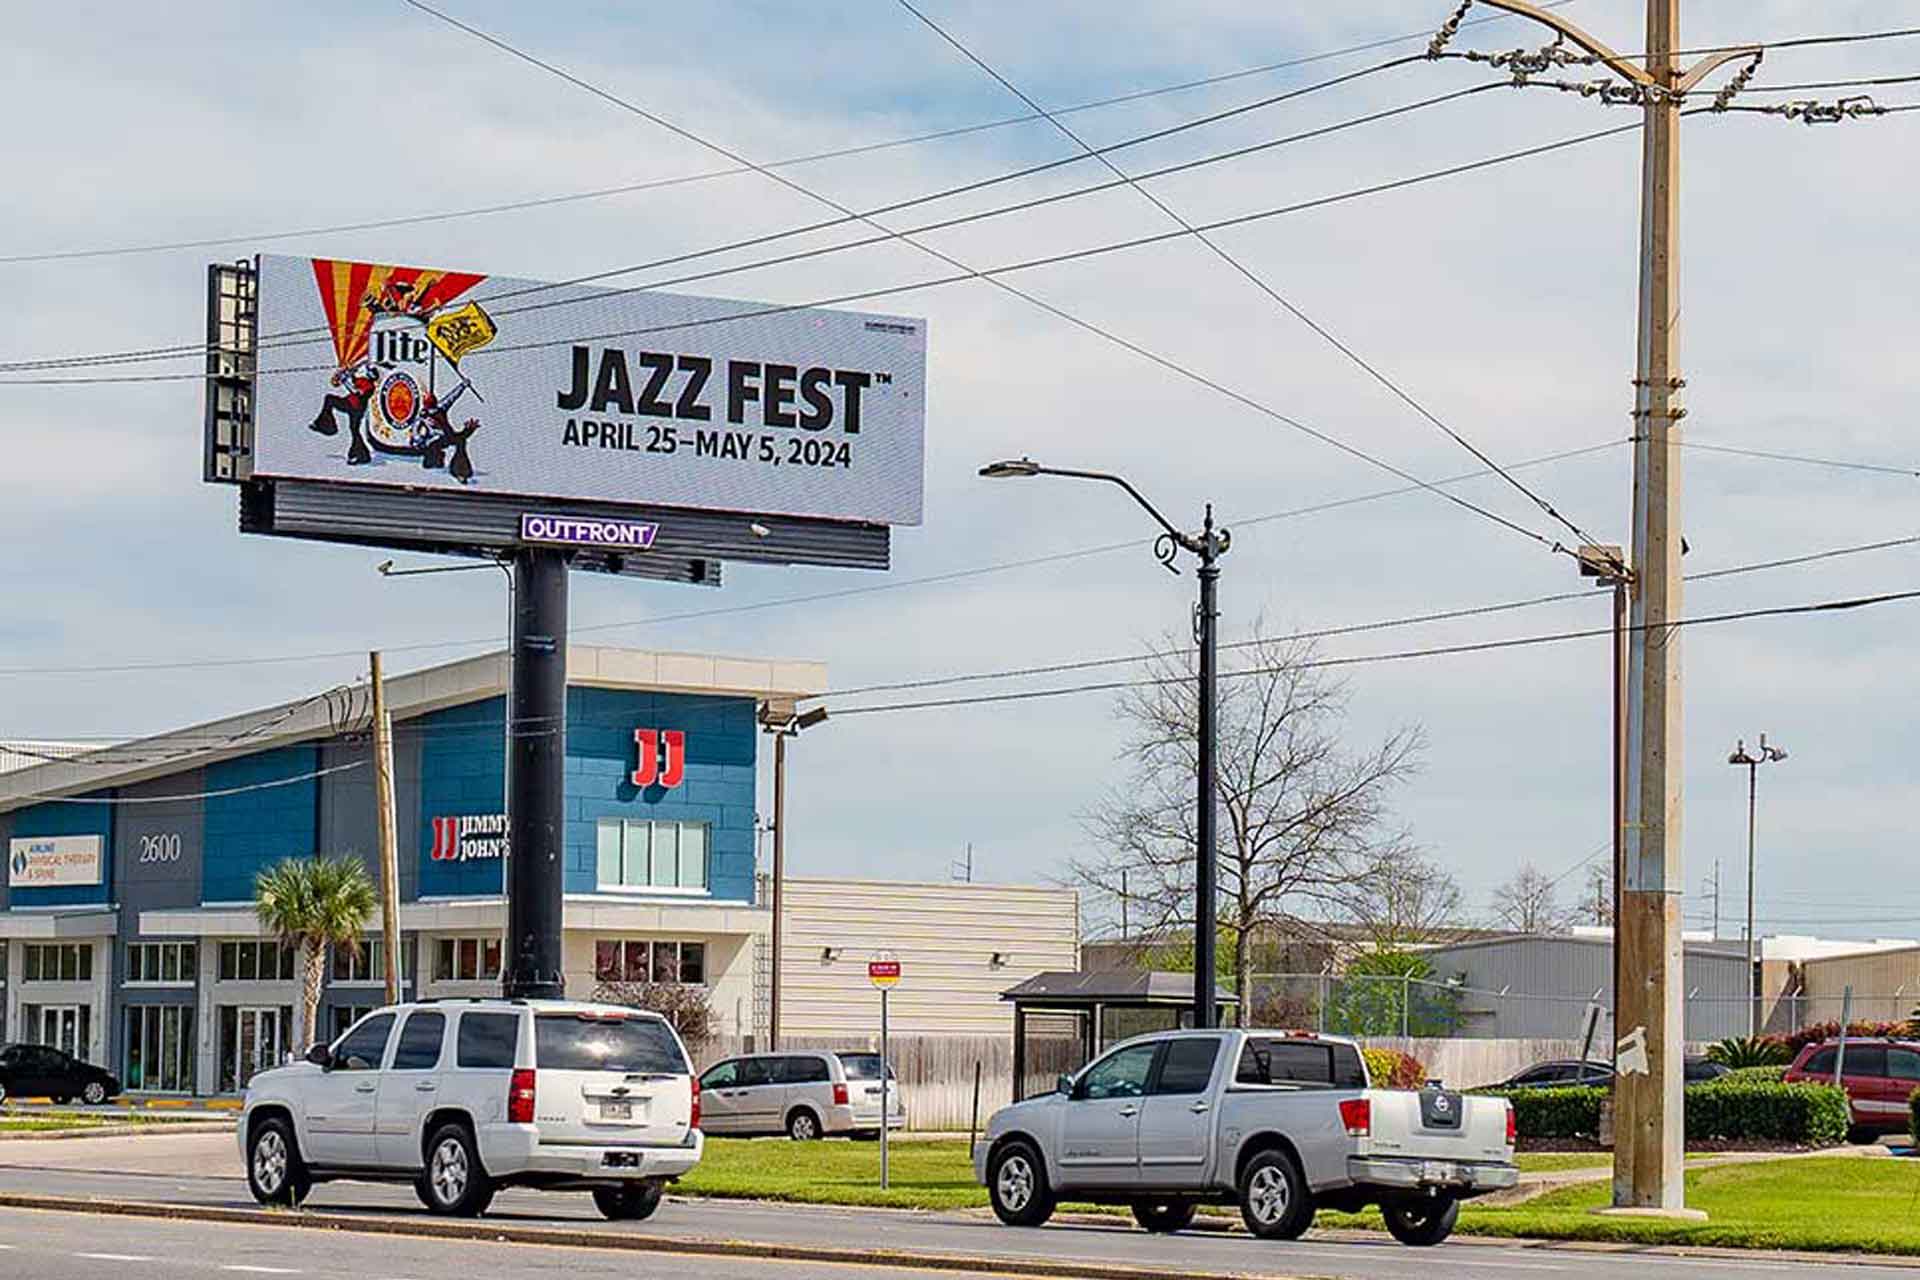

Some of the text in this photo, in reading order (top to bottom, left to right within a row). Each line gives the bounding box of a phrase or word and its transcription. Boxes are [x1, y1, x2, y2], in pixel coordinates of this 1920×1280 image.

[371, 329, 428, 369] Lite
[556, 345, 712, 421] JAZZ
[562, 419, 640, 450] APRIL
[759, 436, 782, 466] 5,
[787, 438, 851, 468] 2024
[528, 518, 649, 543] OUTFRONT
[461, 814, 511, 837] JIMMY
[139, 833, 182, 863] 2600
[461, 838, 511, 862] JOHN'S
